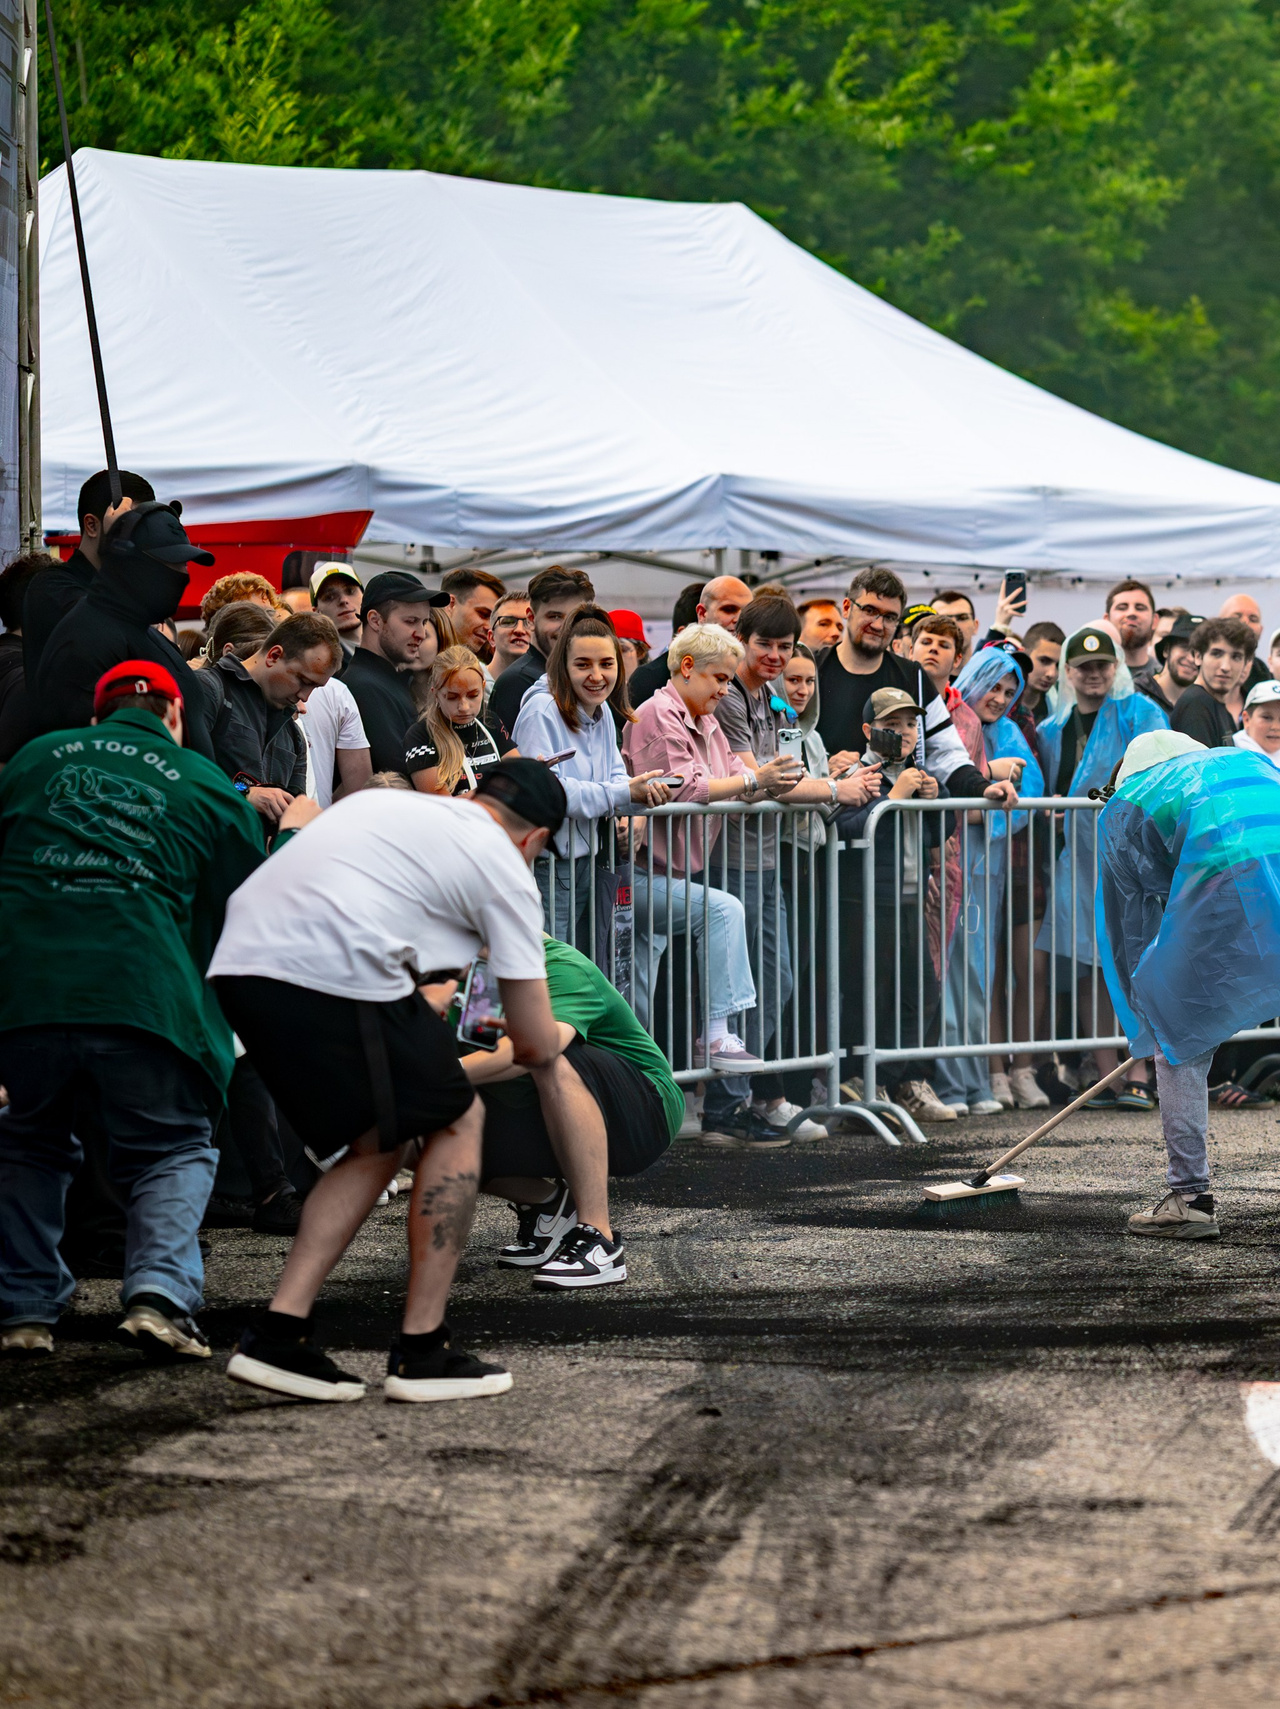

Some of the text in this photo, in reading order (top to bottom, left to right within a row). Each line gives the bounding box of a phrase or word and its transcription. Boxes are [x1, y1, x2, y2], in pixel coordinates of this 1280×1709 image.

[52, 740, 181, 781] I'M TOO OLD
[32, 843, 70, 866] For
[73, 849, 109, 867] this
